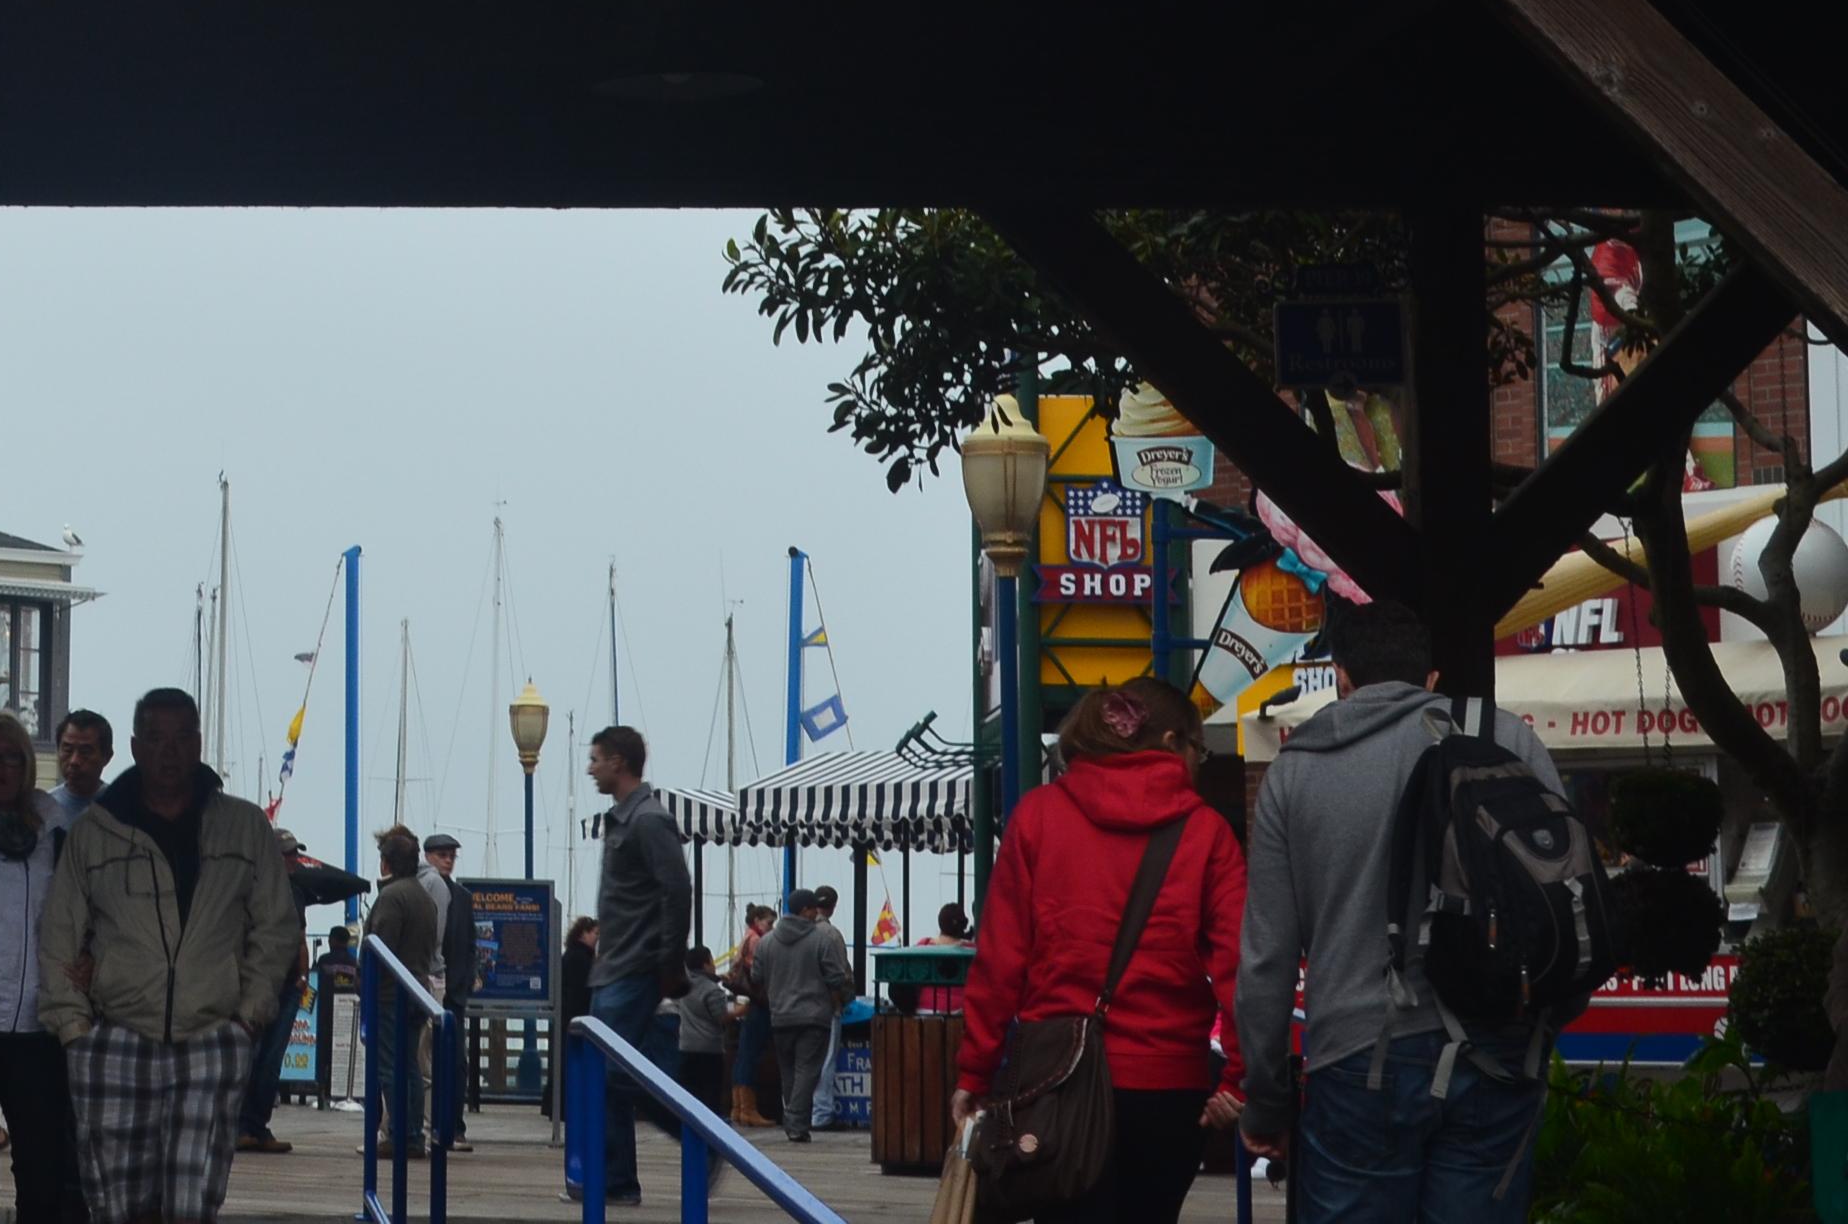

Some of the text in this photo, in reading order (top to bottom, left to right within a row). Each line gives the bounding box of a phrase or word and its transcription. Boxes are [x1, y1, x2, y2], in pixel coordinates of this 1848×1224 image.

[1139, 447, 1191, 463] Dreyer's
[1150, 464, 1183, 477] Frozen
[1150, 474, 1184, 487] Yogurt
[1071, 518, 1142, 565] NFL
[1059, 572, 1151, 597] SHOP
[1551, 597, 1624, 646] NFL
[1218, 630, 1264, 675] Dreyer's
[1292, 666, 1337, 697] SHO
[1570, 709, 1627, 736] HOT
[1747, 700, 1790, 729] OT
